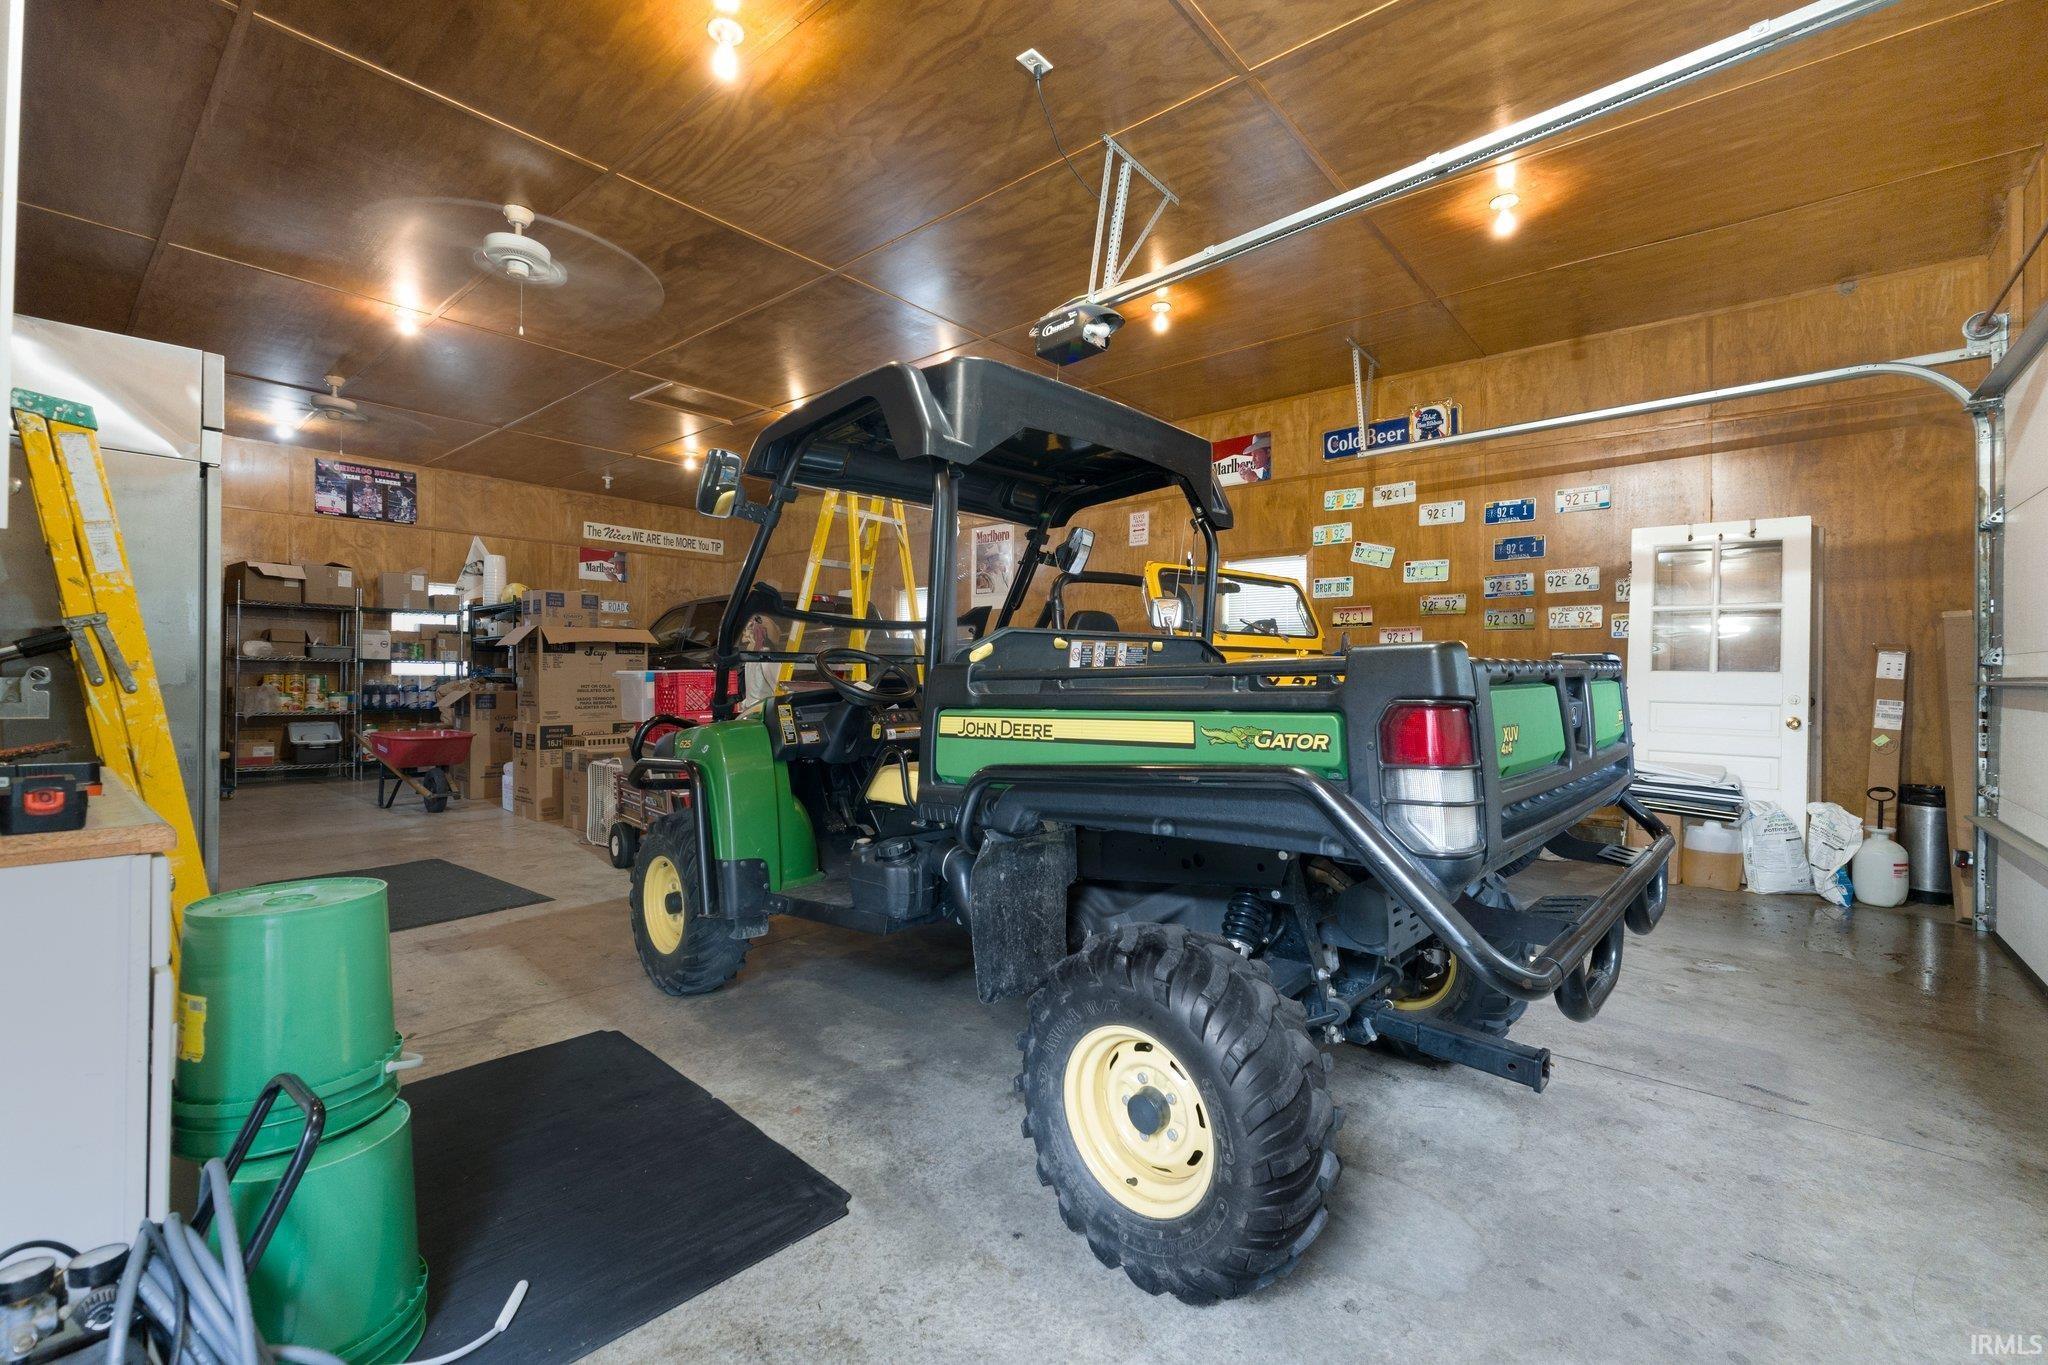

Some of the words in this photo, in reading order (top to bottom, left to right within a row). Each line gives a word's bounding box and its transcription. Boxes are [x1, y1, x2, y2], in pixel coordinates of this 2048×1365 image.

[1042, 319, 1075, 336] Quantum
[1326, 429, 1361, 454] Cold
[1366, 427, 1405, 446] Beer
[334, 465, 373, 475] CHICAGO
[374, 469, 400, 480] BULLS
[1497, 507, 1507, 518] 92
[587, 524, 602, 537] The
[603, 526, 632, 541] Nicer
[632, 531, 645, 543] WE
[646, 533, 662, 545] ARE
[663, 535, 675, 547] the
[675, 536, 696, 550] MORE
[698, 539, 710, 552] You
[711, 541, 722, 552] TIP
[976, 530, 1010, 543] Marlboro
[1490, 581, 1502, 592] 92
[1515, 579, 1529, 591] 35
[1574, 573, 1590, 586] 26
[1316, 583, 1332, 594] BRGR
[1336, 582, 1350, 592] BUG
[608, 601, 625, 611] ROAD
[1445, 599, 1457, 610] 92
[1487, 614, 1499, 626] 92
[1512, 613, 1526, 625] 30
[1577, 611, 1592, 623] 92
[1614, 620, 1629, 632] 92
[958, 718, 997, 736] JOHN
[1000, 719, 1054, 739] DEERE
[1503, 725, 1519, 742] XUV
[1254, 729, 1330, 751] GATOR
